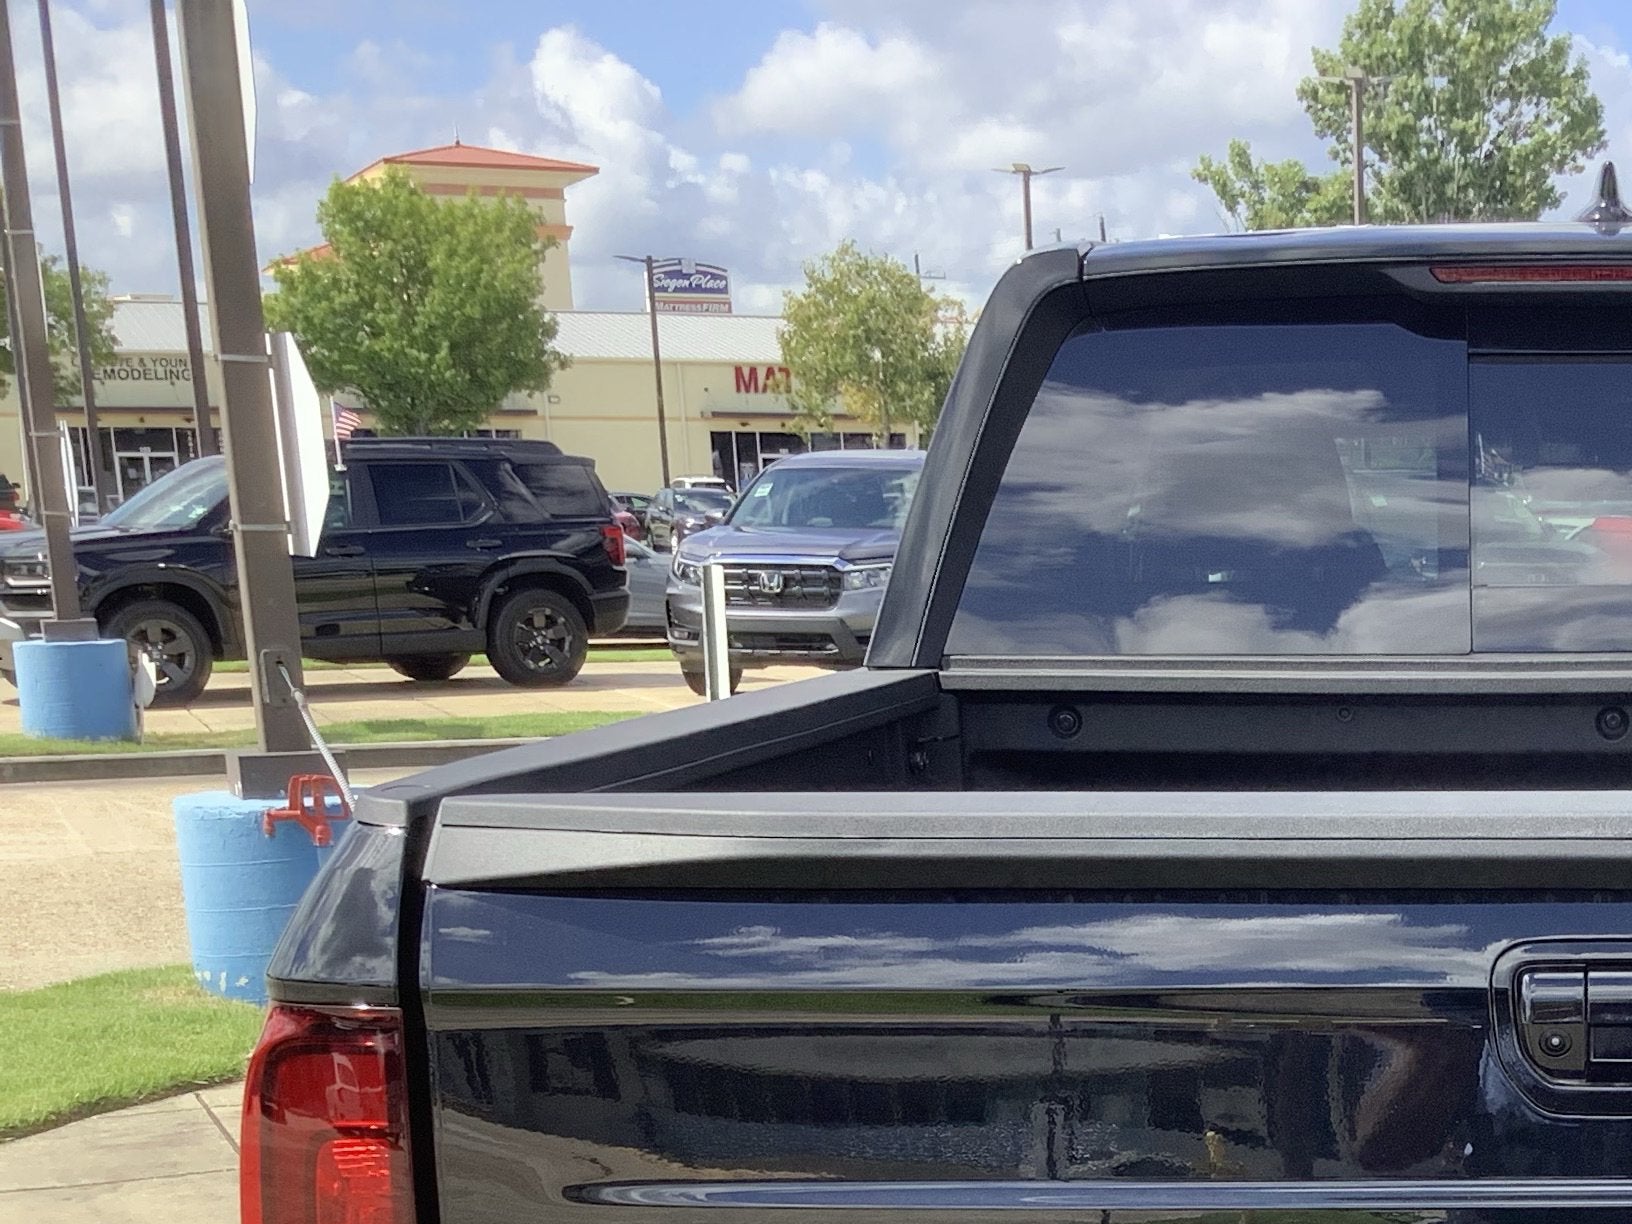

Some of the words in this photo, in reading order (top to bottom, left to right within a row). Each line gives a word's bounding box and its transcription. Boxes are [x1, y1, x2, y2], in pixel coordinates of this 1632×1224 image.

[689, 273, 727, 289] Place
[702, 303, 729, 313] FIRM
[150, 357, 188, 369] YOUN
